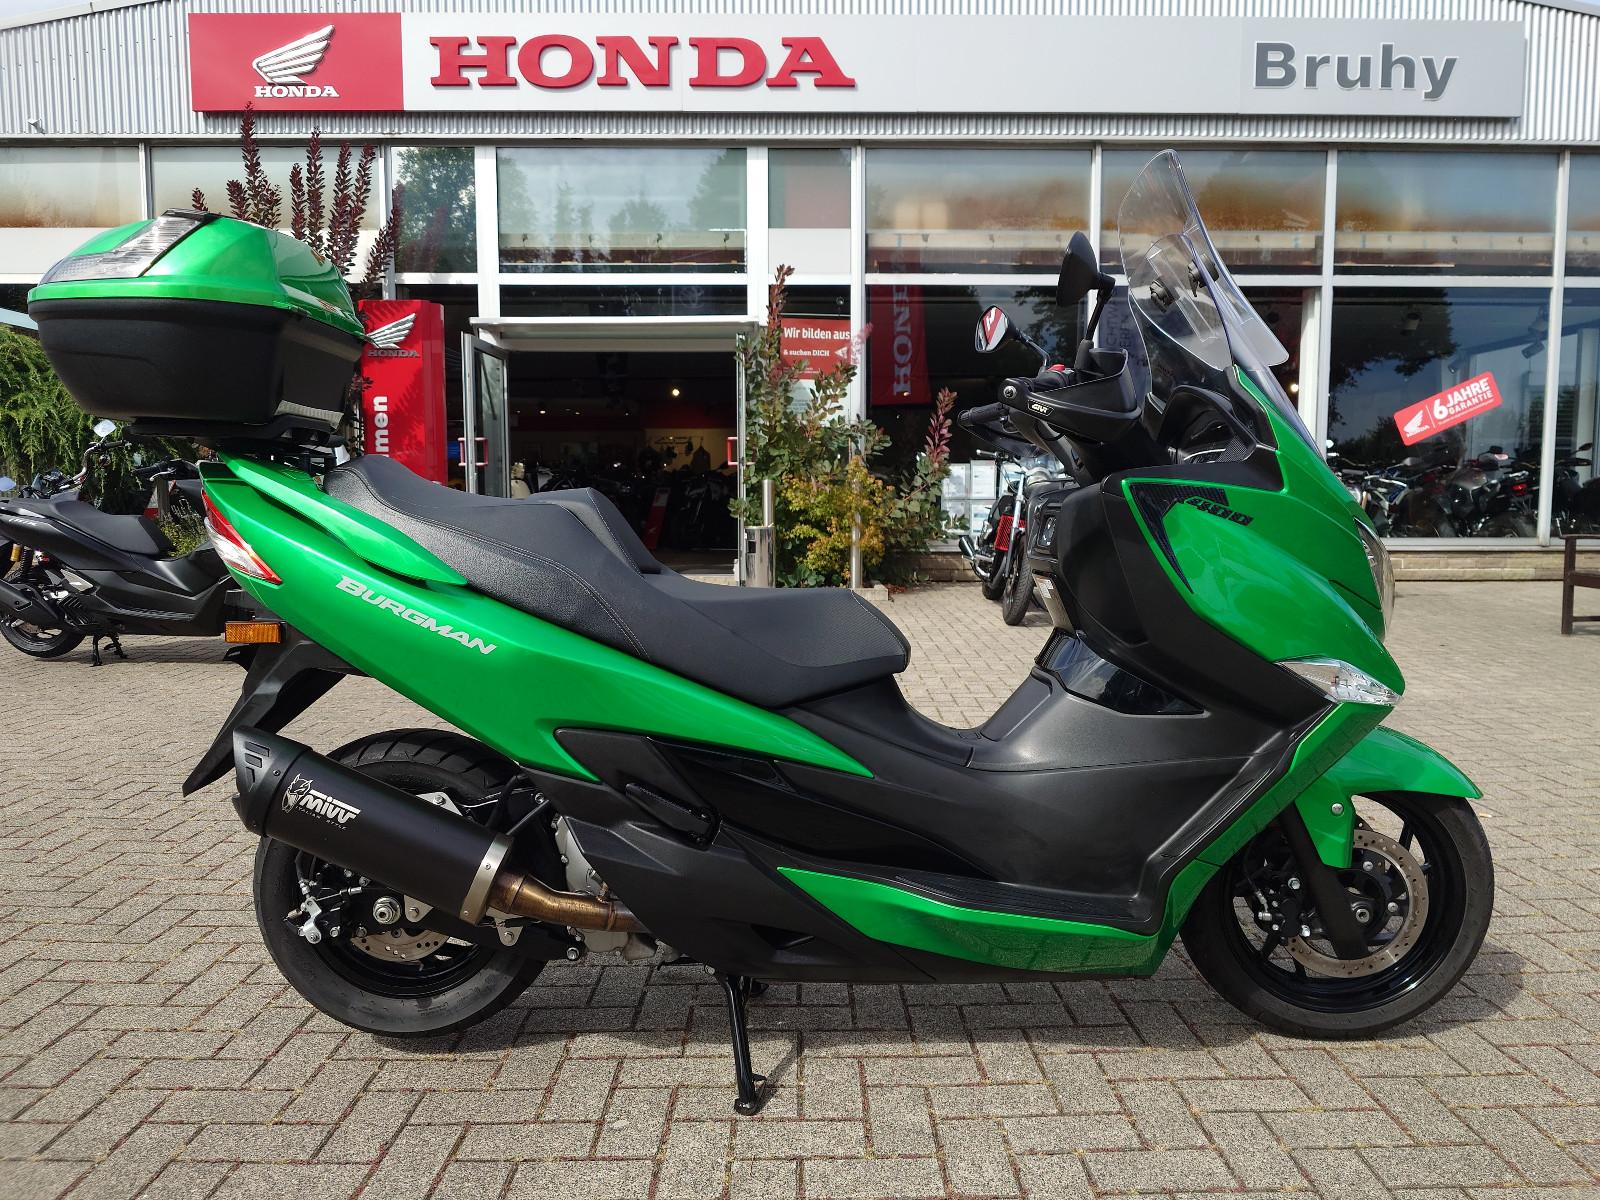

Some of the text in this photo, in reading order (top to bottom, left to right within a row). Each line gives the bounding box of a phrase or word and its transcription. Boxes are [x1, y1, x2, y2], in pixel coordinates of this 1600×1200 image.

[429, 34, 857, 89] HONDA
[1254, 41, 1459, 101] Bruhy
[254, 85, 340, 98] HONDA
[783, 327, 851, 340] Wir bilden aus
[367, 350, 420, 358] HONDA
[812, 349, 830, 357] DICH
[1433, 398, 1449, 420] 6
[1446, 377, 1491, 407] JAHRE
[1448, 390, 1494, 415] GARANTIE
[372, 395, 390, 458] men
[335, 574, 497, 655] BURGMAN
